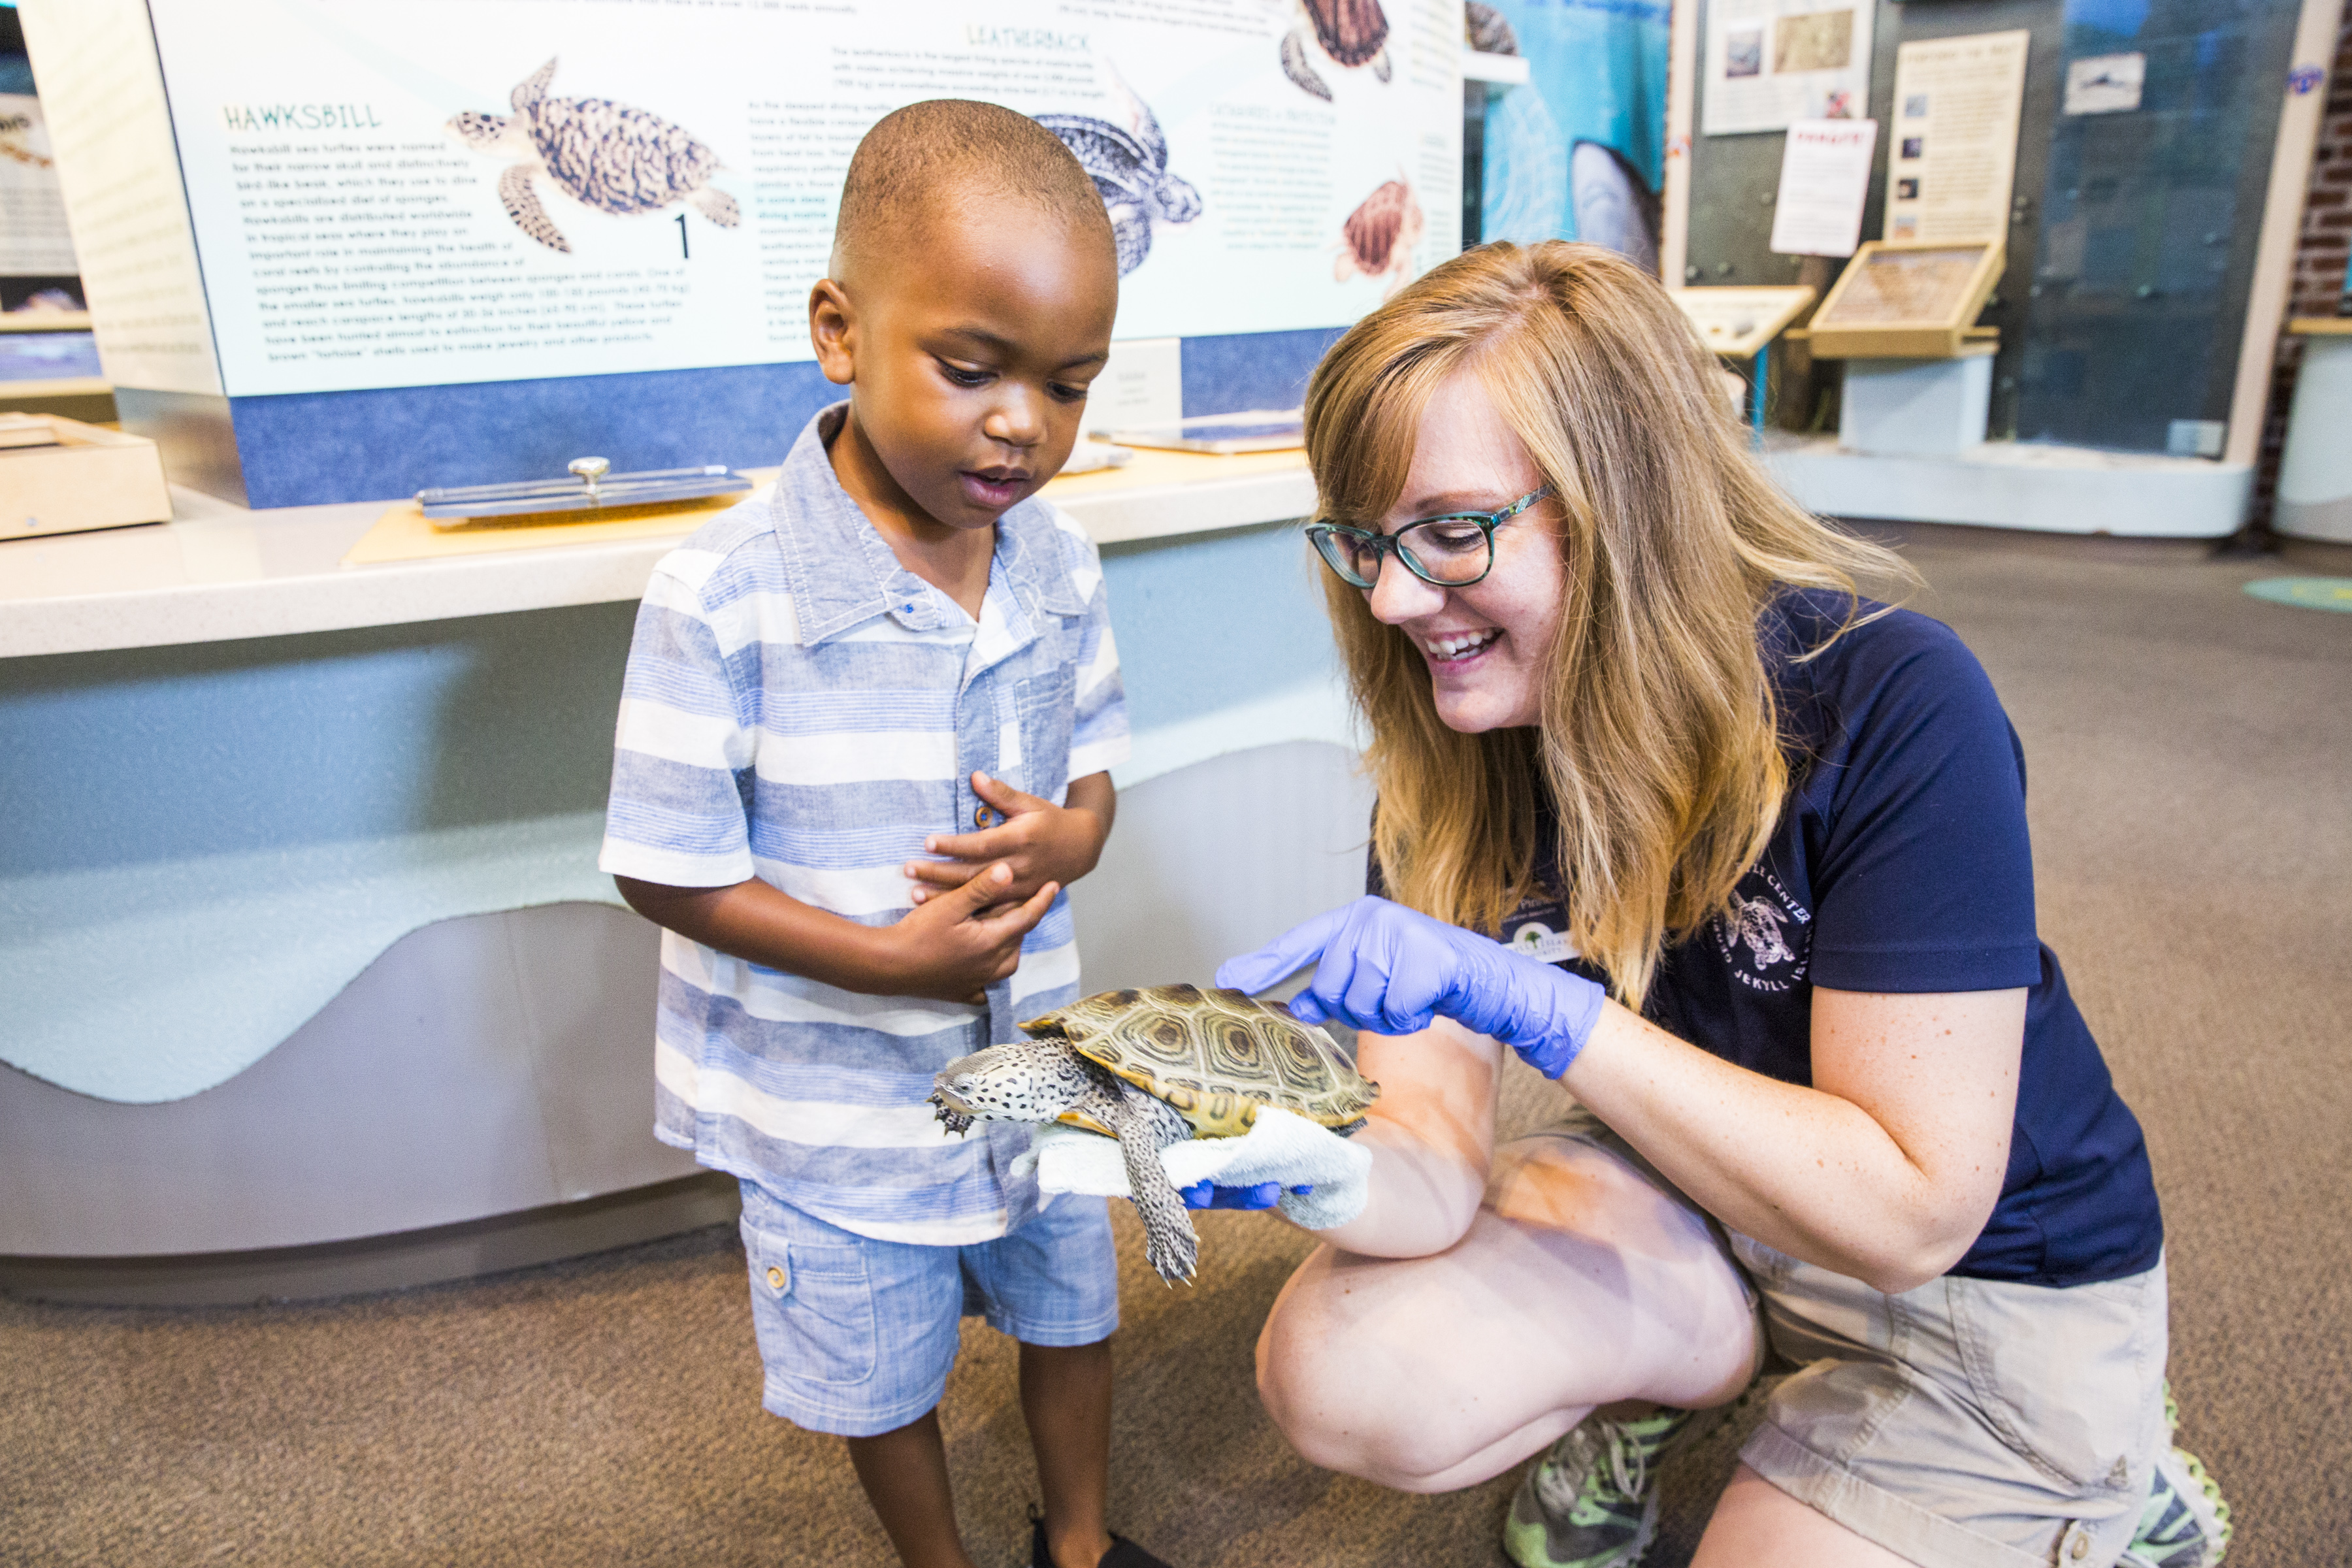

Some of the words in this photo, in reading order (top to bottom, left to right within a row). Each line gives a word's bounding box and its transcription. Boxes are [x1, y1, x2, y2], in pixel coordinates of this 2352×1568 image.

[967, 24, 1092, 54] LEATHERBACK
[224, 103, 384, 131] HAWKSBILL
[674, 213, 689, 259] 1
[1767, 874, 1812, 925] CENTER
[1734, 968, 1790, 992] JEKYLL
